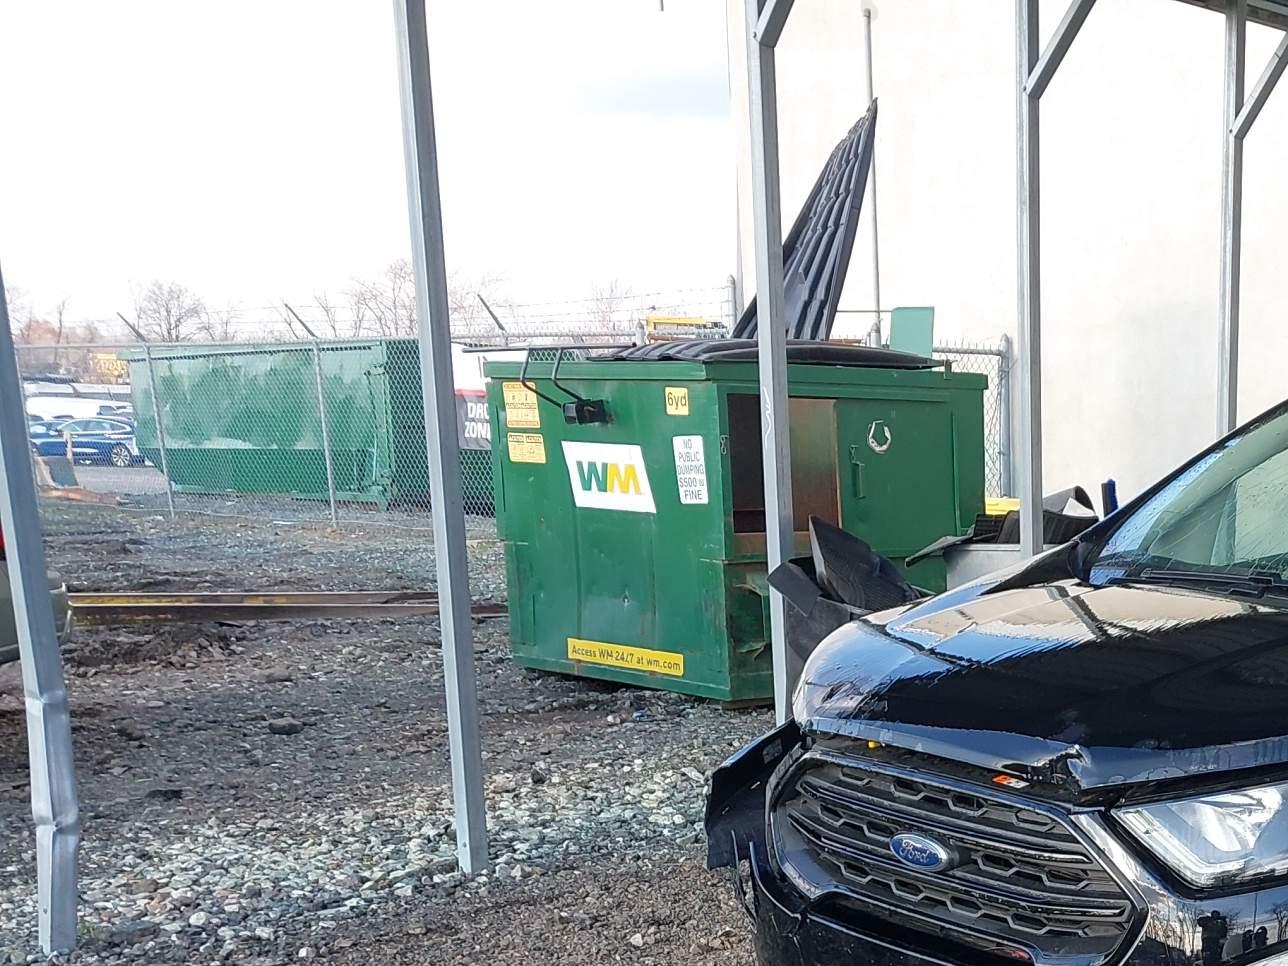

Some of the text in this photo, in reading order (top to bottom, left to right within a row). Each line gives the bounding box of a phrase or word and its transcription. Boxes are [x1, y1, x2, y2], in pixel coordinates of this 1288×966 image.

[667, 391, 687, 409] 6yd
[683, 439, 692, 449] NO
[678, 452, 700, 462] PUBLIC
[576, 460, 641, 495] WM
[677, 464, 704, 476] DUMPING
[684, 490, 703, 500] FINE
[572, 643, 597, 657] Access
[615, 650, 634, 664] 24/7
[636, 656, 644, 665] at
[646, 658, 681, 671] wm.com
[899, 839, 930, 864] Ford
